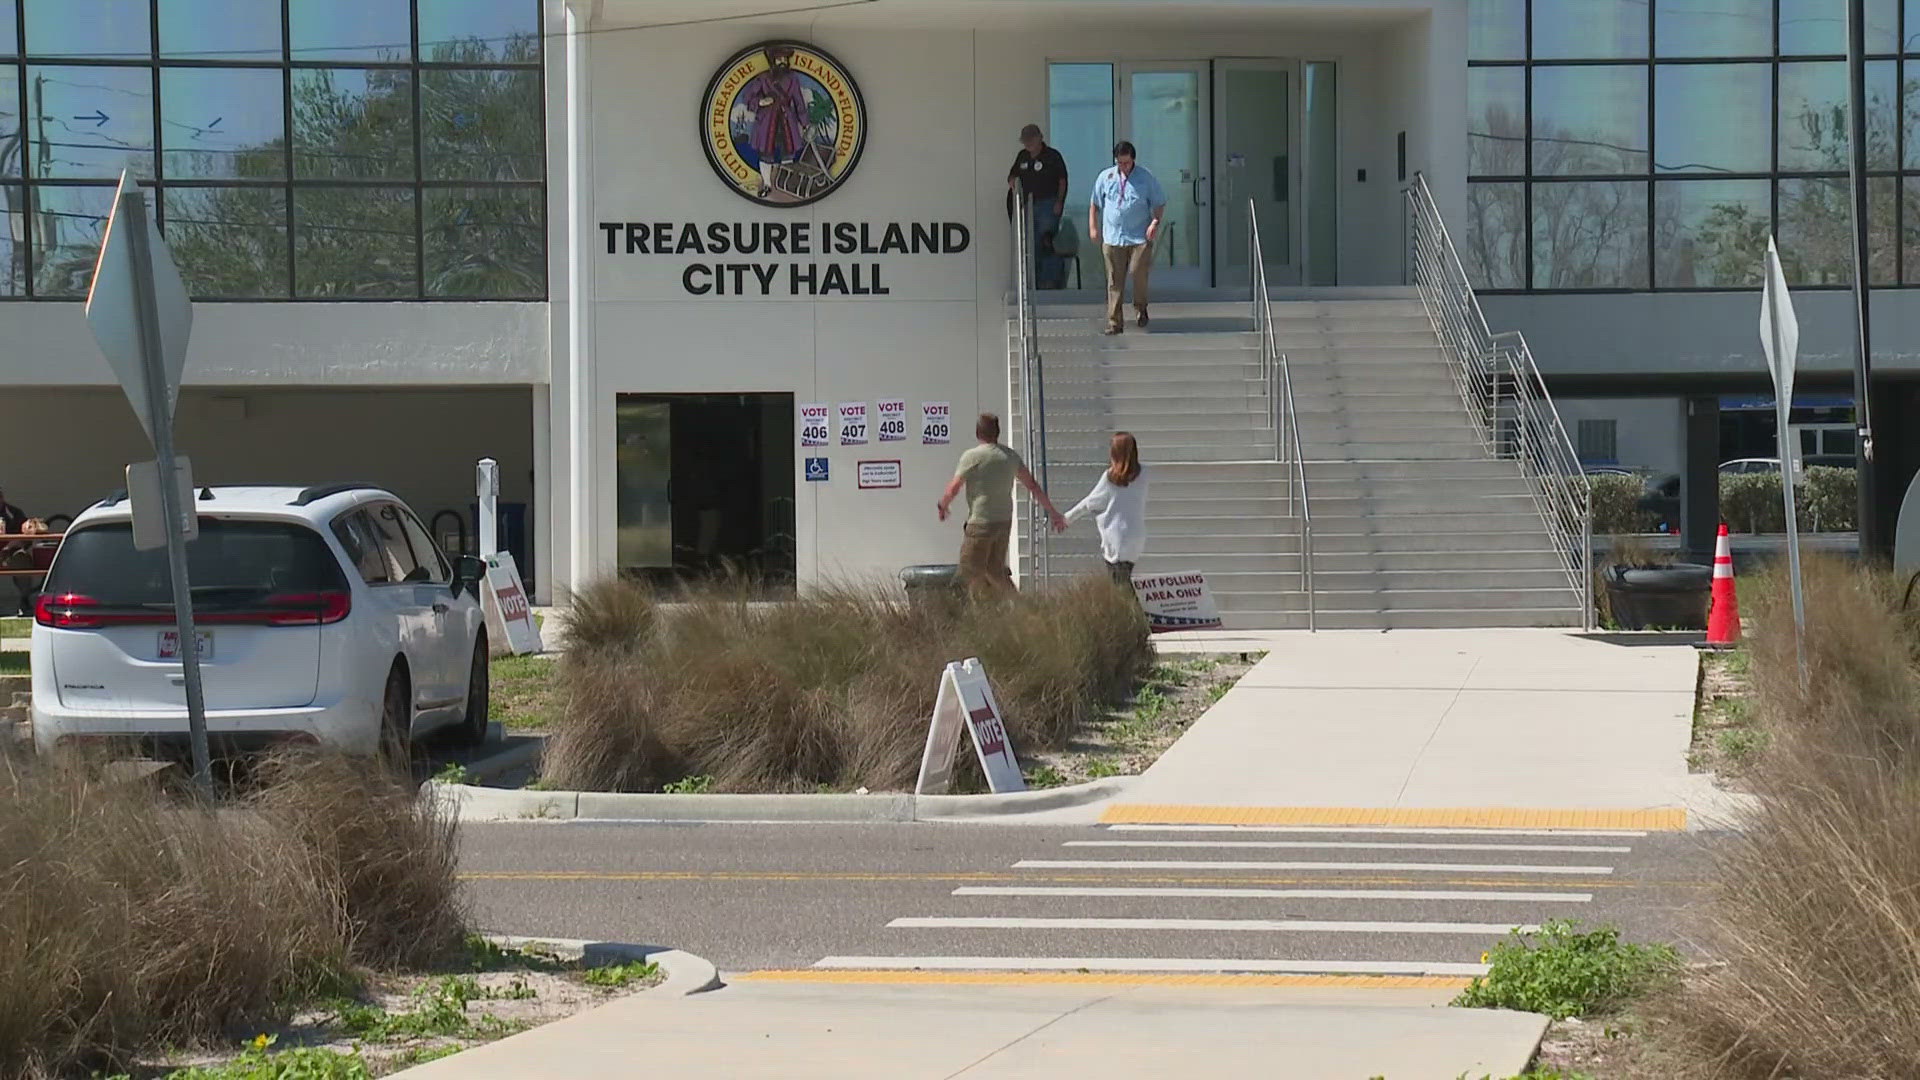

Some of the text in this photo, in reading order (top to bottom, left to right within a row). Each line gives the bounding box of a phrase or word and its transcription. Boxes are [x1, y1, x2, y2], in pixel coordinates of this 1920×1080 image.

[713, 54, 854, 180] CITY OF TREASURE ISLAND FLORIDA
[600, 222, 971, 254] TREASURE ISLAND
[682, 263, 890, 295] CITY HALL
[801, 407, 828, 417] VOTE
[840, 406, 866, 416] VOTE
[879, 402, 905, 412] VOTE
[923, 406, 949, 415] VOTE
[802, 426, 827, 439] 406
[841, 424, 866, 438] 407
[880, 420, 905, 434] 408
[923, 424, 949, 437] 409
[1134, 575, 1203, 590] EXIT POLLING
[1145, 587, 1202, 602] AREA ONLY
[500, 594, 527, 615] VOTE
[973, 718, 1002, 746] VOTE
